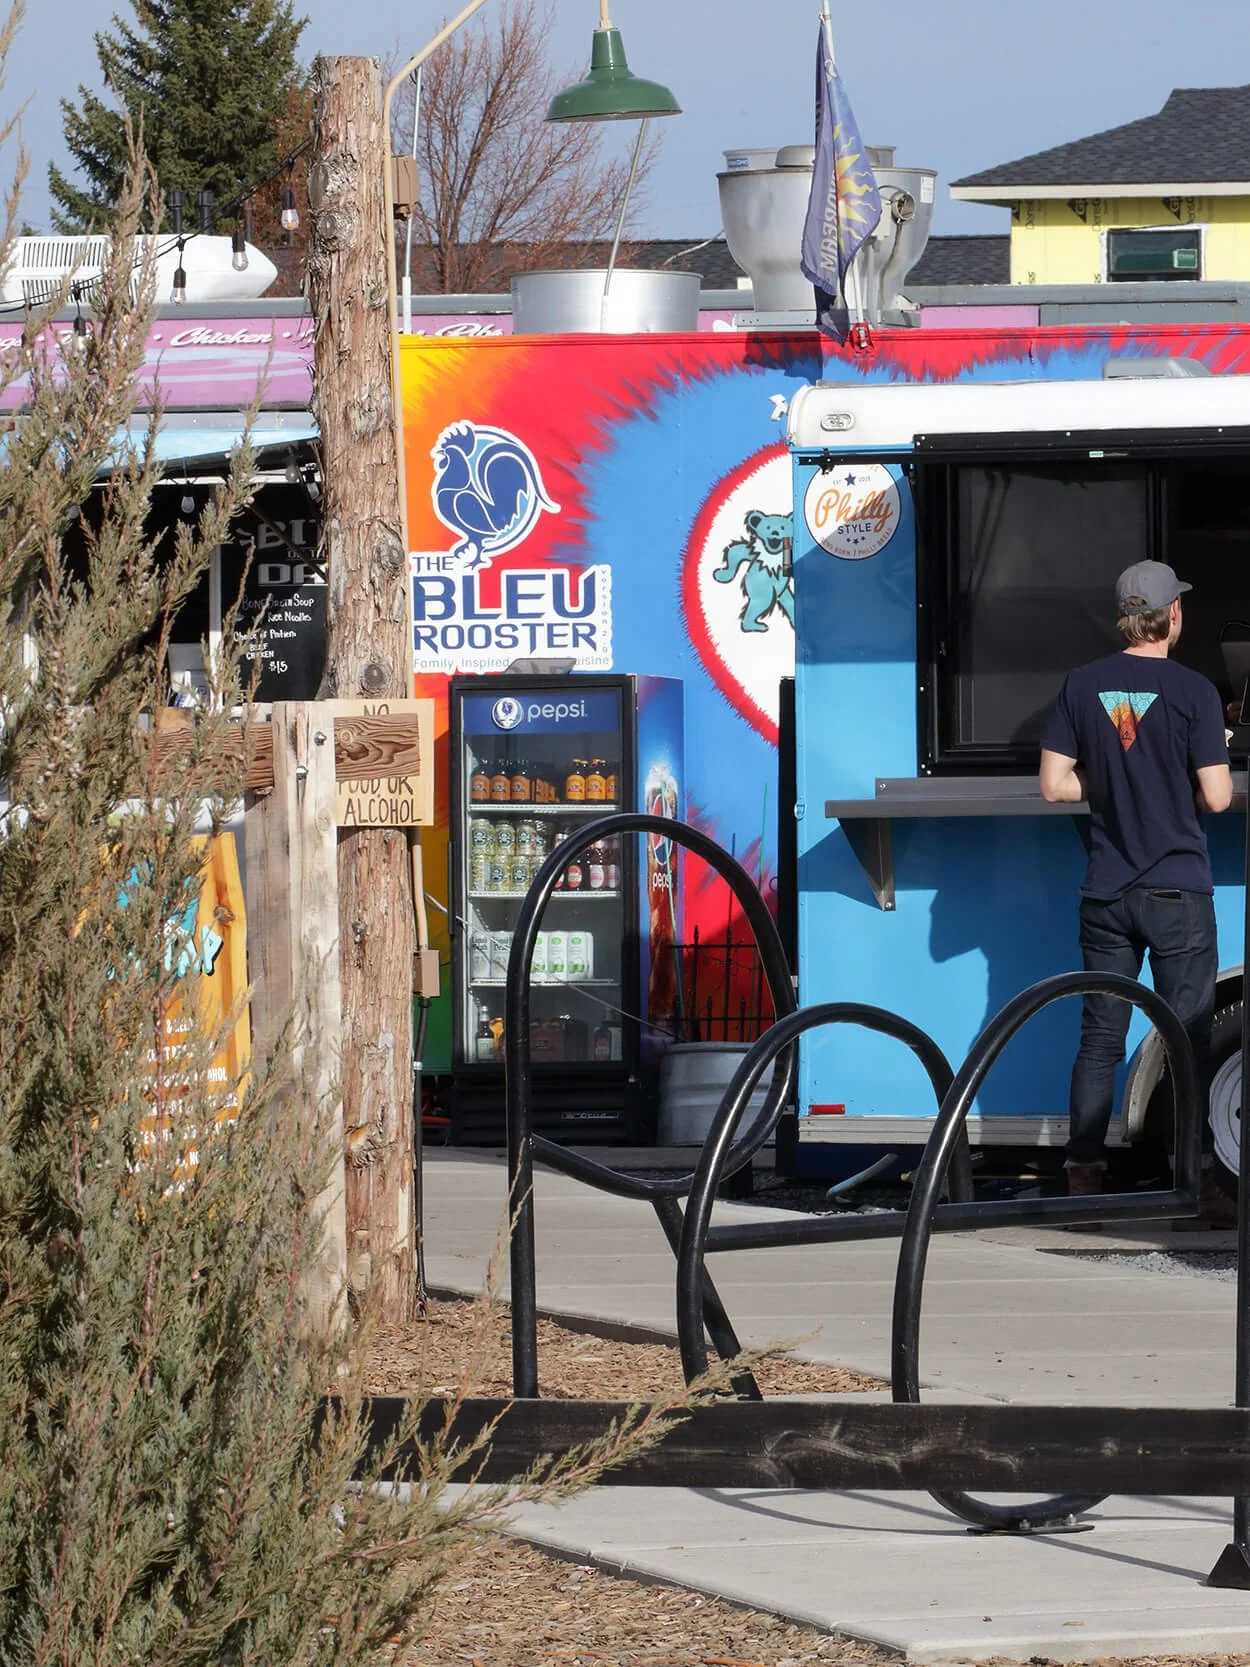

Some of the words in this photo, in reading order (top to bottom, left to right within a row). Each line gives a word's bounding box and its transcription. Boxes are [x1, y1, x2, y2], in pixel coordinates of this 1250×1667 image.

[169, 327, 273, 348] Chicken
[815, 488, 894, 533] Philly
[837, 523, 872, 535] STYLE
[412, 556, 455, 573] THE
[413, 570, 596, 621] BLEU
[414, 622, 597, 654] ROOSTER
[268, 661, 289, 674] $15
[414, 656, 454, 670] Family
[461, 656, 510, 670] Inspired
[528, 700, 585, 723] pepsi
[344, 798, 422, 826] ALCOHOL
